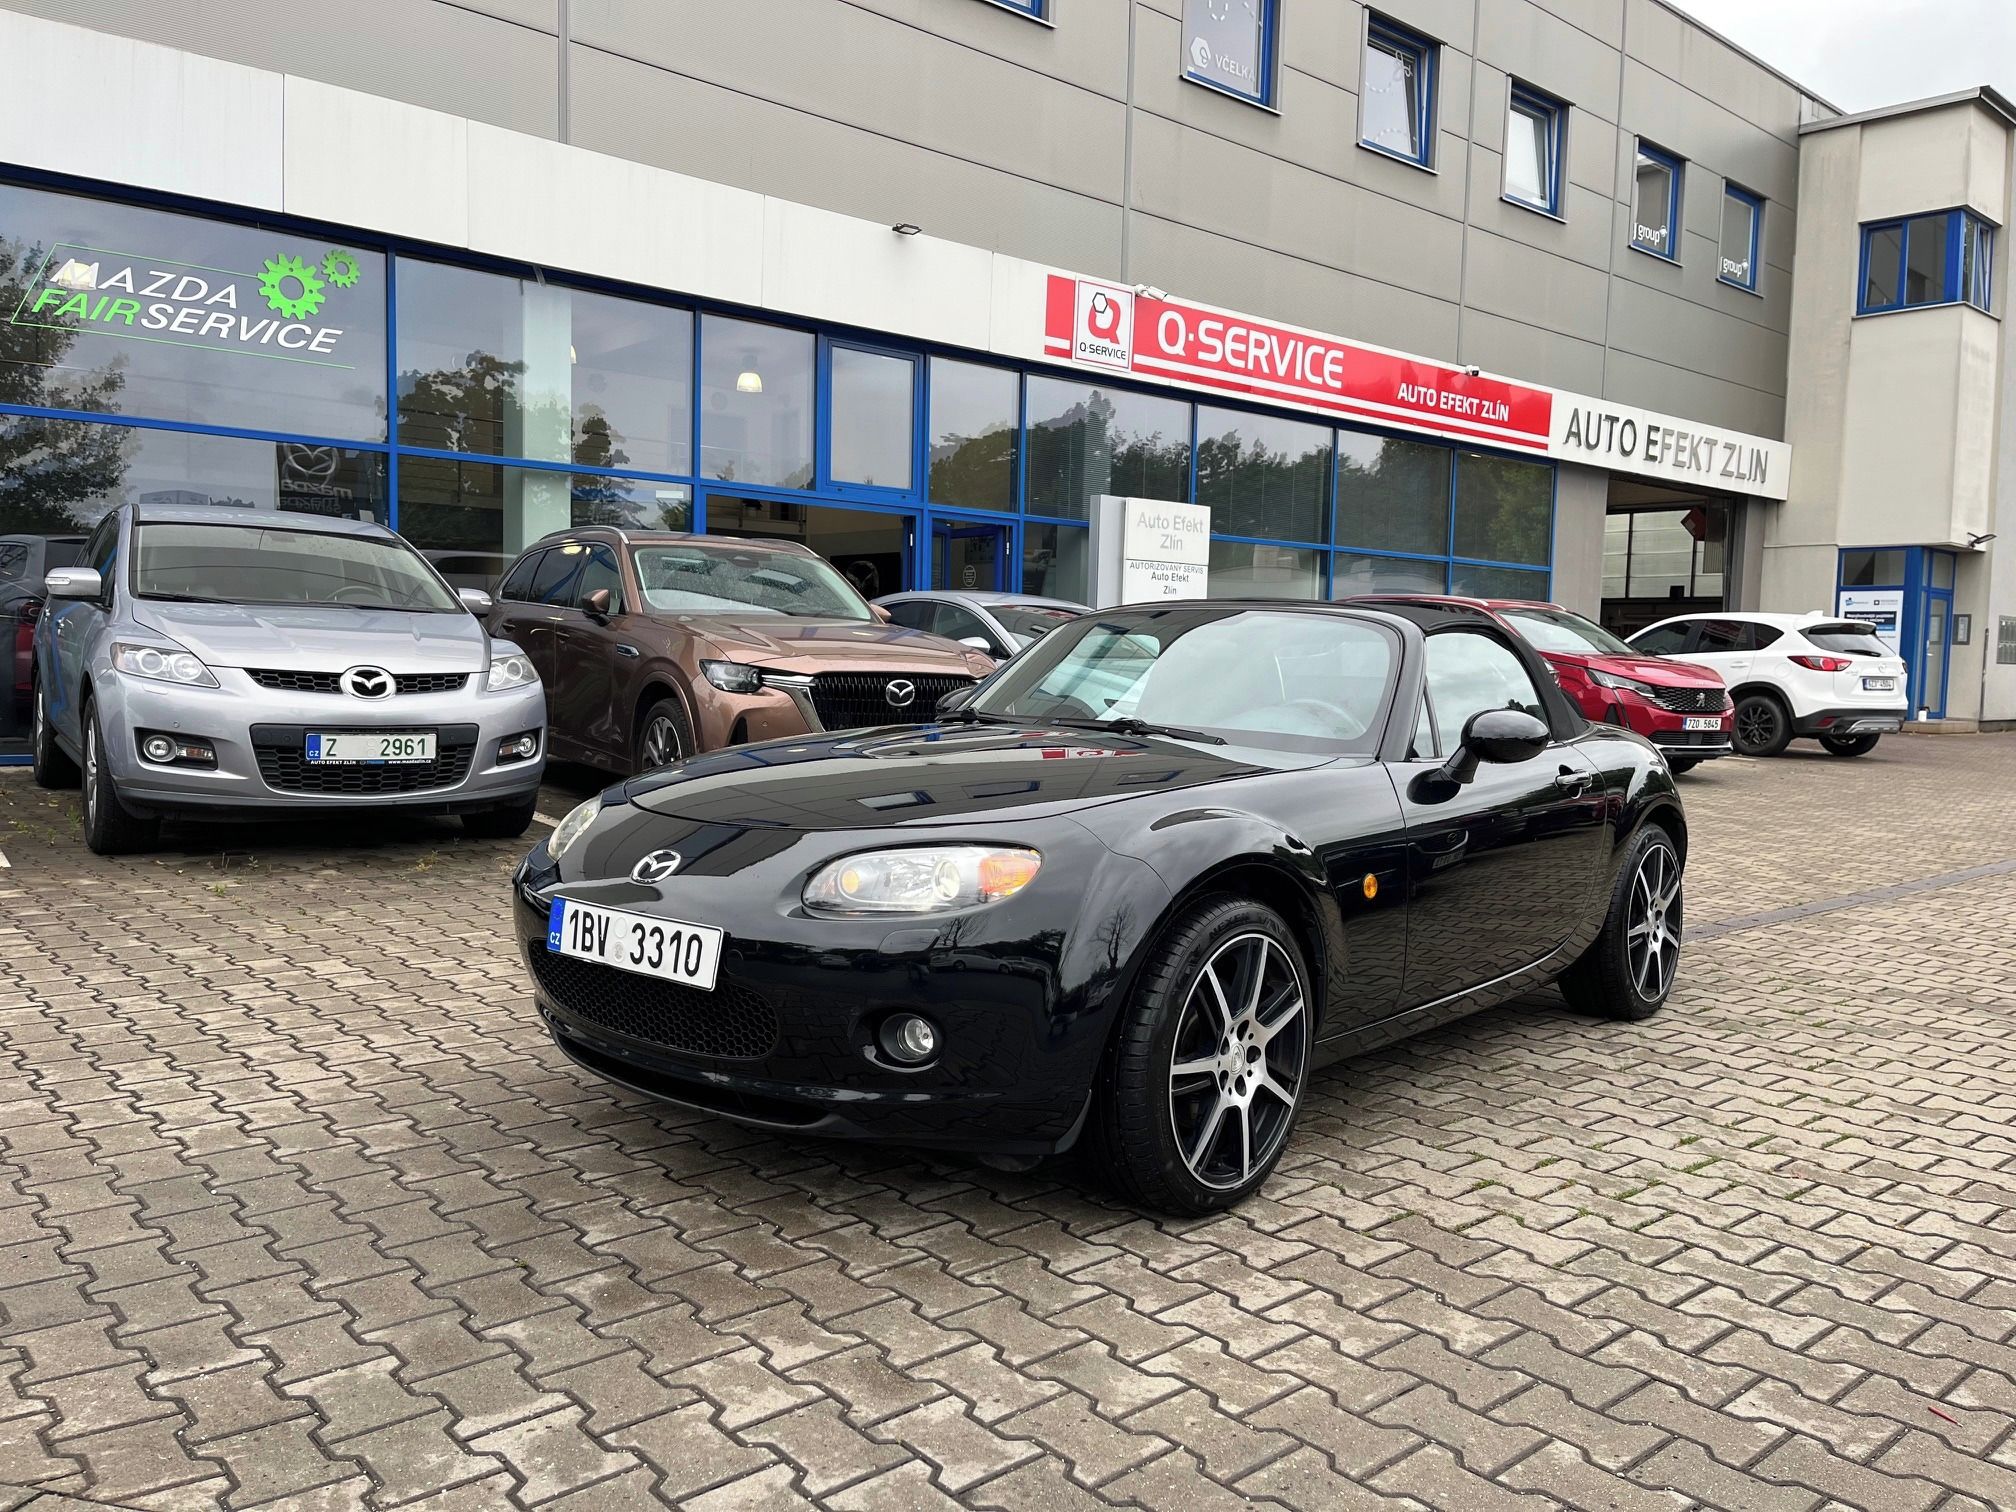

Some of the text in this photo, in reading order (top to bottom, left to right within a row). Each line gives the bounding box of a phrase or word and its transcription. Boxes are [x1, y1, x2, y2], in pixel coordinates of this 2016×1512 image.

[1638, 224, 1660, 246] group
[1723, 258, 1742, 278] group
[50, 258, 237, 309] MAZDA
[1397, 382, 1509, 422] AUTO EFEKT ZLÍN
[1563, 407, 1769, 484] AUTO EFEKT ZLIN
[1137, 511, 1204, 533] Auto Efekt
[1151, 572, 1190, 583] Auto Efekt
[1183, 566, 1204, 575] SERVIS
[1703, 719, 1719, 729] 5845
[325, 738, 426, 757] Z 2961
[549, 931, 560, 945] CZ
[569, 908, 703, 977] 1BV 3310
